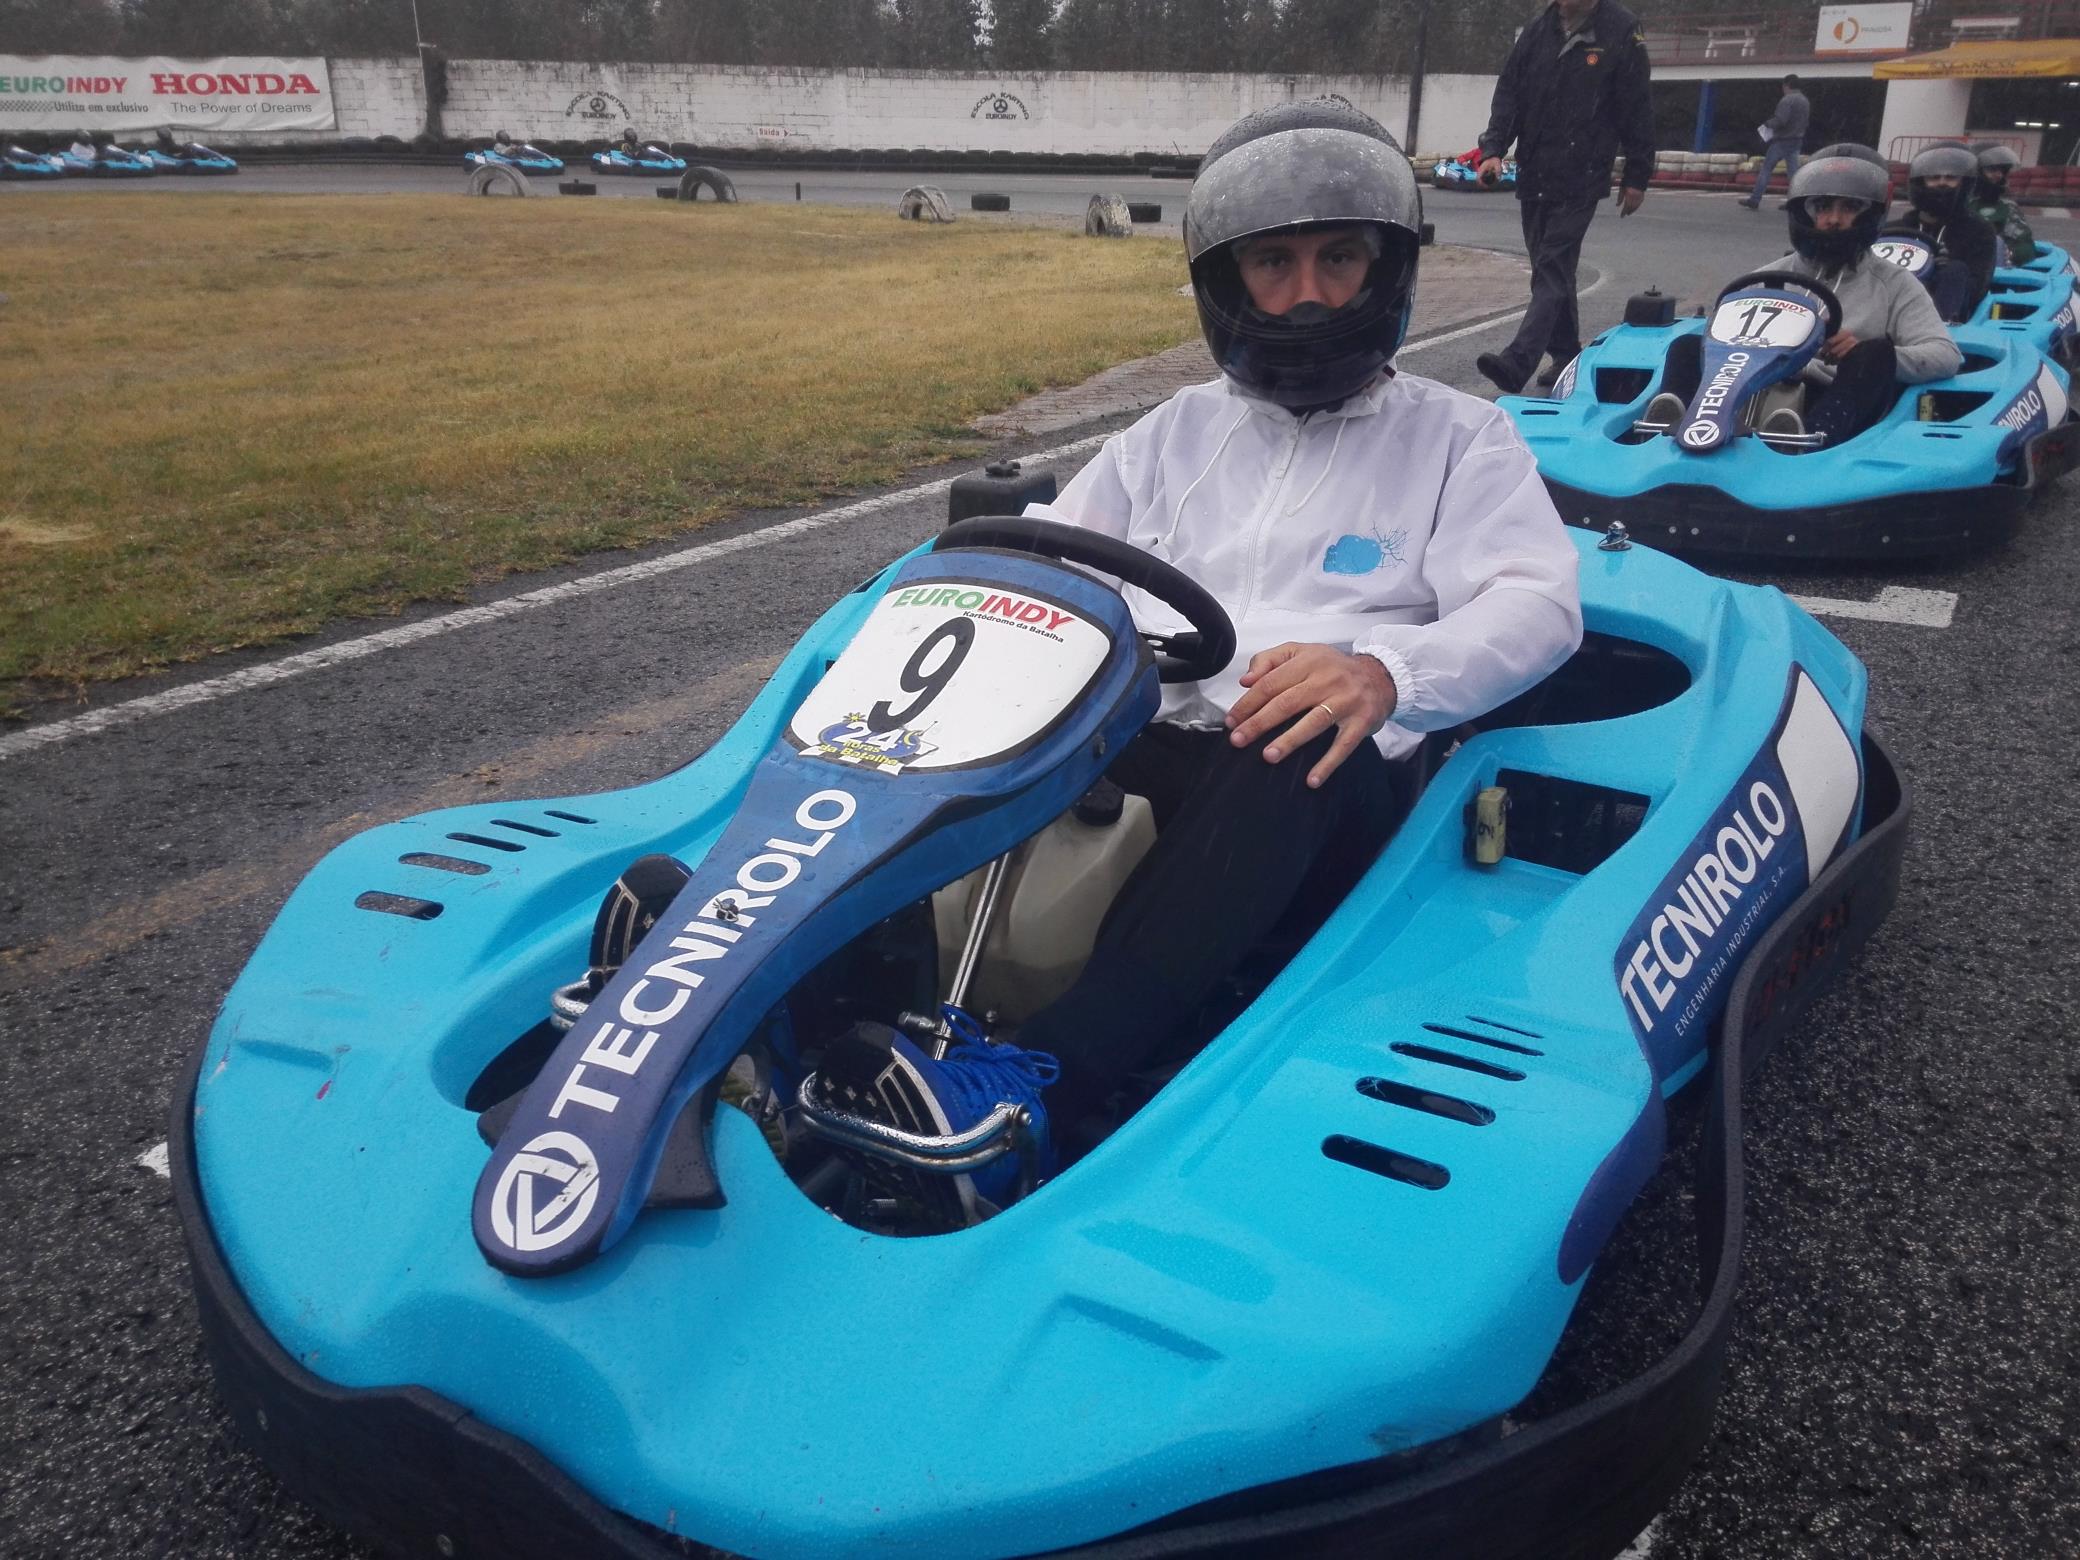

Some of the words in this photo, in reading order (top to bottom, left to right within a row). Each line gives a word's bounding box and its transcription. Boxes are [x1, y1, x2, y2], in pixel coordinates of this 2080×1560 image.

[0, 76, 128, 94] EUROINDY
[150, 73, 320, 95] HONDA
[54, 101, 86, 112] Utiliza
[88, 104, 104, 113] em
[106, 101, 149, 113] exclusivo
[171, 102, 197, 113] The
[201, 102, 241, 113] Power
[245, 101, 258, 113] of
[262, 102, 312, 114] Dreams
[970, 92, 996, 119] ESCOLA
[1000, 92, 1029, 120] KARTING
[1880, 246, 1915, 268] 28
[1735, 299, 1808, 314] EUROINDY
[1740, 304, 1783, 338] 17
[1696, 352, 1750, 419] TECNIROLO
[890, 588, 1076, 631] EUROINDY
[962, 610, 1015, 627] Kartódromo
[1016, 622, 1028, 630] da
[1029, 626, 1064, 643] Batalha
[867, 617, 976, 732] 9
[831, 721, 905, 752] 24
[1620, 781, 1786, 1033] TECNIROLO
[548, 788, 857, 1119] TECNIROLO
[1674, 956, 1727, 1037] ENGENHARIA
[1771, 866, 1787, 888] S.A.
